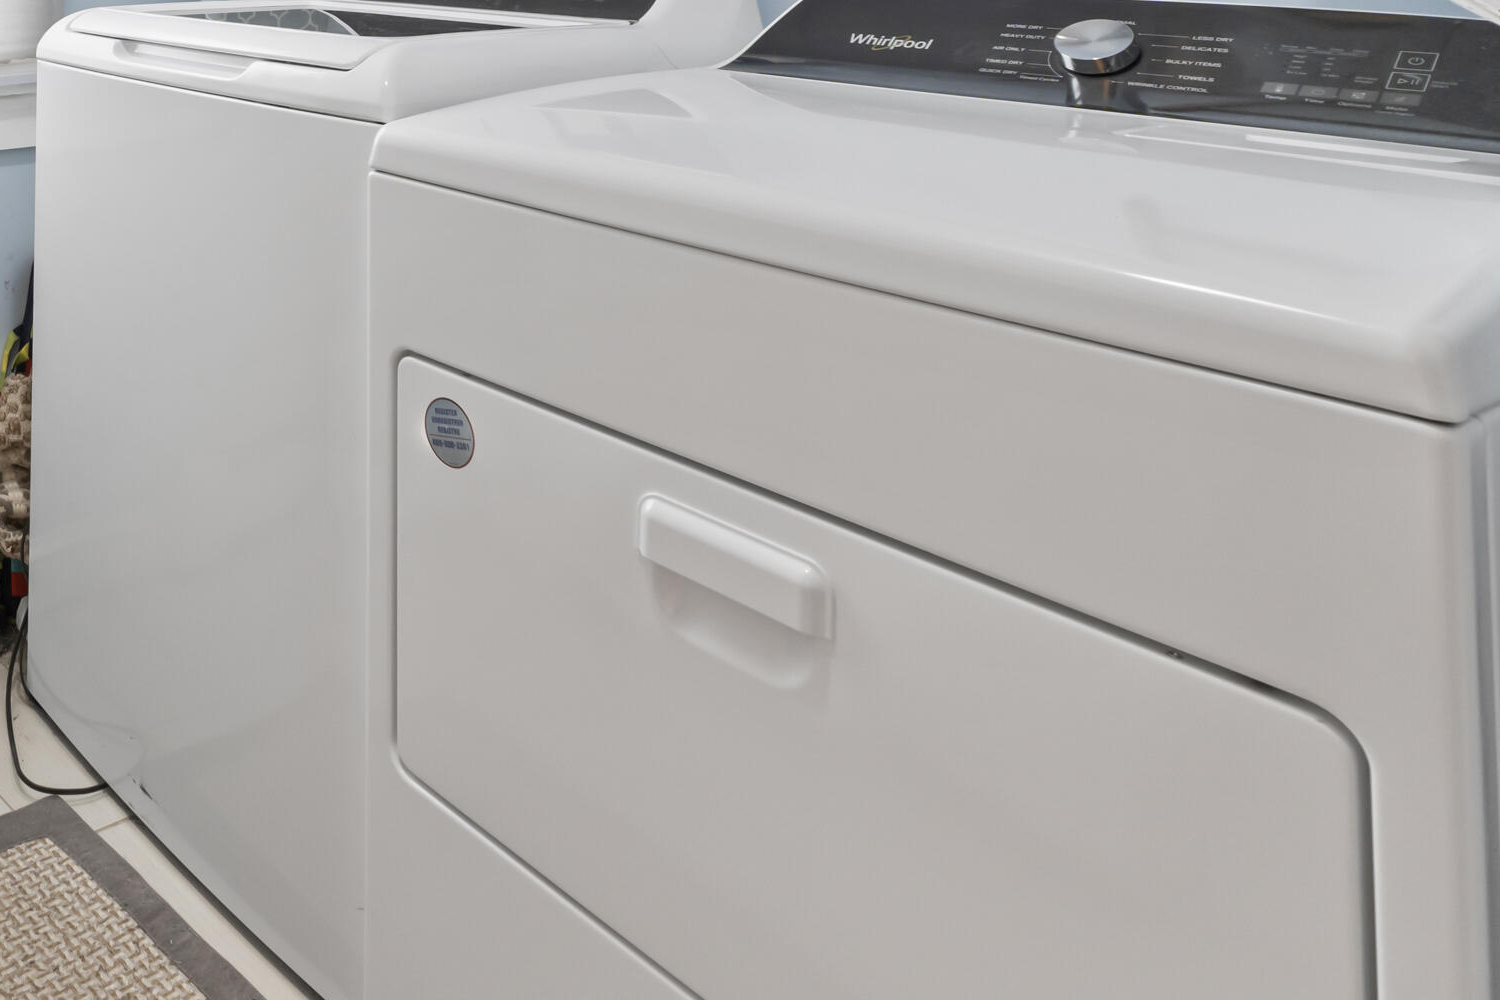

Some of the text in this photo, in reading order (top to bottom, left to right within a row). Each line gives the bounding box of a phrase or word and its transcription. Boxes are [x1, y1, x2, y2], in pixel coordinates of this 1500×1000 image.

[849, 32, 934, 50] Whirlpool
[1181, 45, 1229, 53] DELICATES
[1165, 58, 1194, 66] BULKY
[1178, 74, 1215, 82] TOWELS
[1127, 81, 1209, 93] WRINKLE CONTROL
